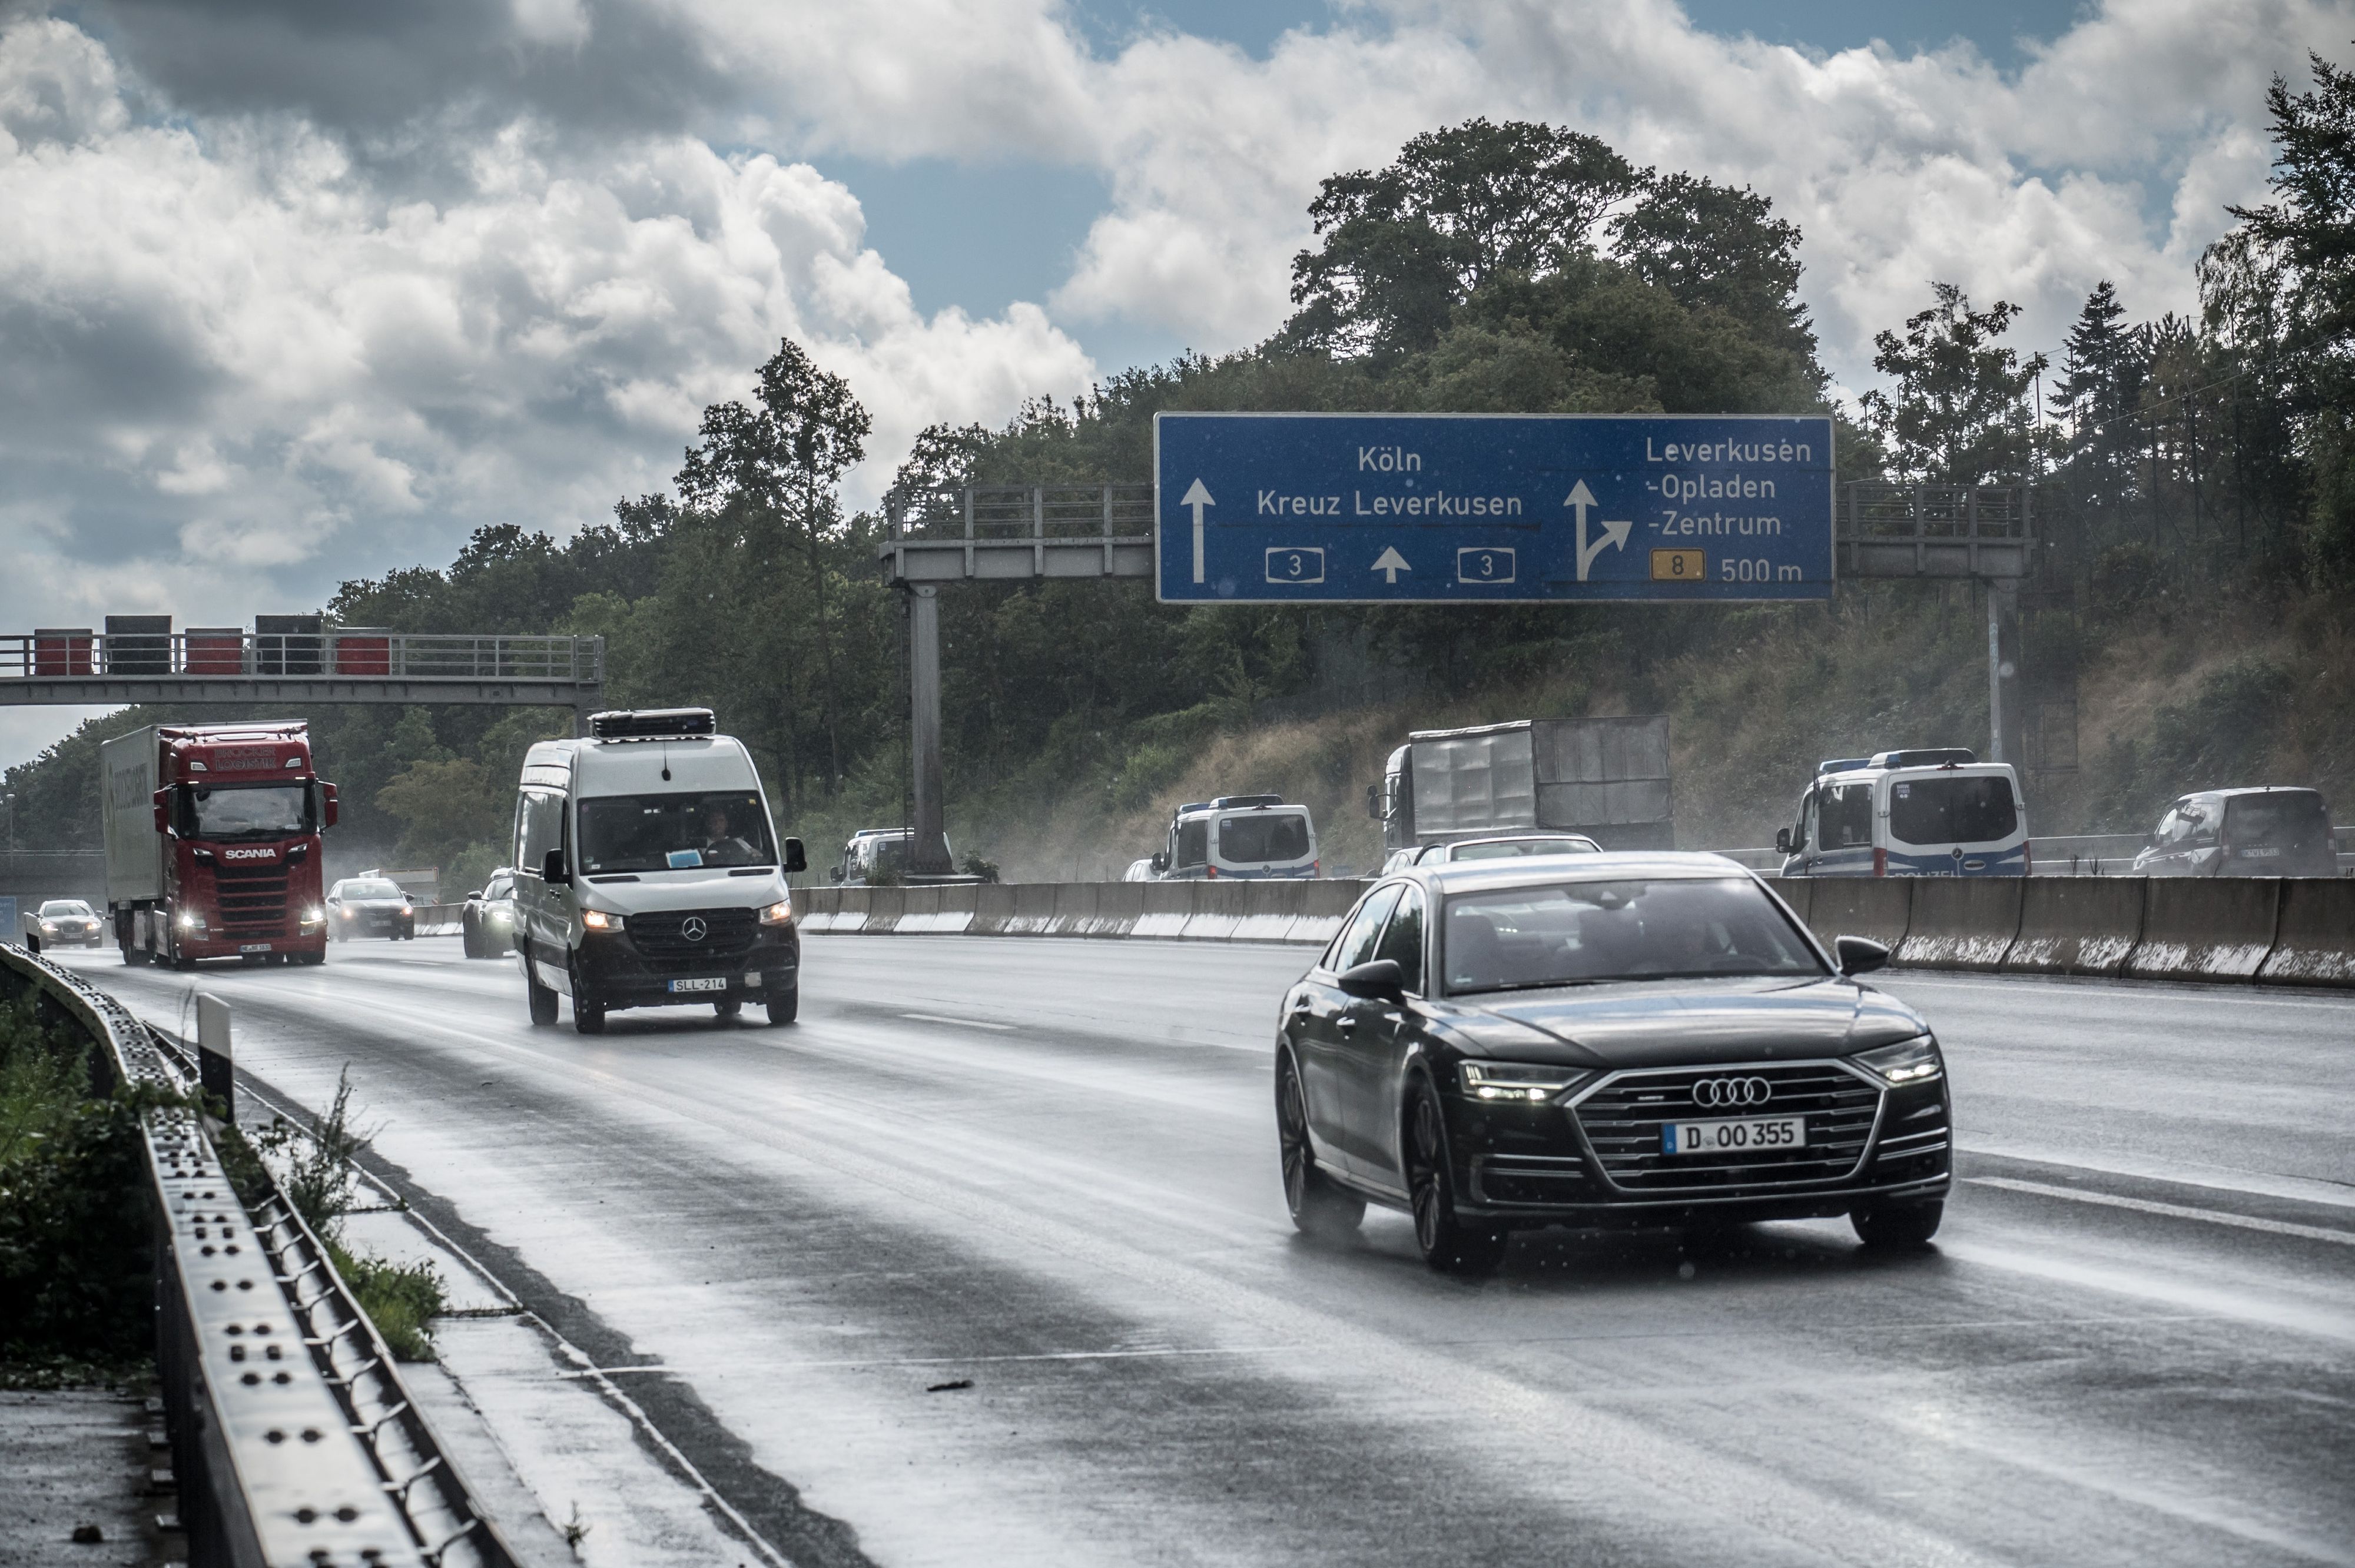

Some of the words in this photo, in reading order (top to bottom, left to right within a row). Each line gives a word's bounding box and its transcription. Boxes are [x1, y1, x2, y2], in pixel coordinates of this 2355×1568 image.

[1359, 446, 1421, 471] Köln
[1647, 437, 1811, 462] Leverkusen
[1647, 474, 1775, 505] -Opladen
[1258, 490, 1341, 515] Kreuz
[1355, 490, 1522, 515] Leverkusen
[1648, 510, 1781, 535] -Zentrum
[1289, 554, 1302, 576] 3
[1481, 554, 1493, 576] 3
[1671, 554, 1684, 576] 8
[1722, 559, 1770, 582] 500
[1778, 564, 1802, 582] m
[225, 848, 276, 859] SCANIA
[676, 979, 724, 991] SLL-214
[1686, 1127, 1701, 1149] D
[1752, 1121, 1795, 1145] 355
